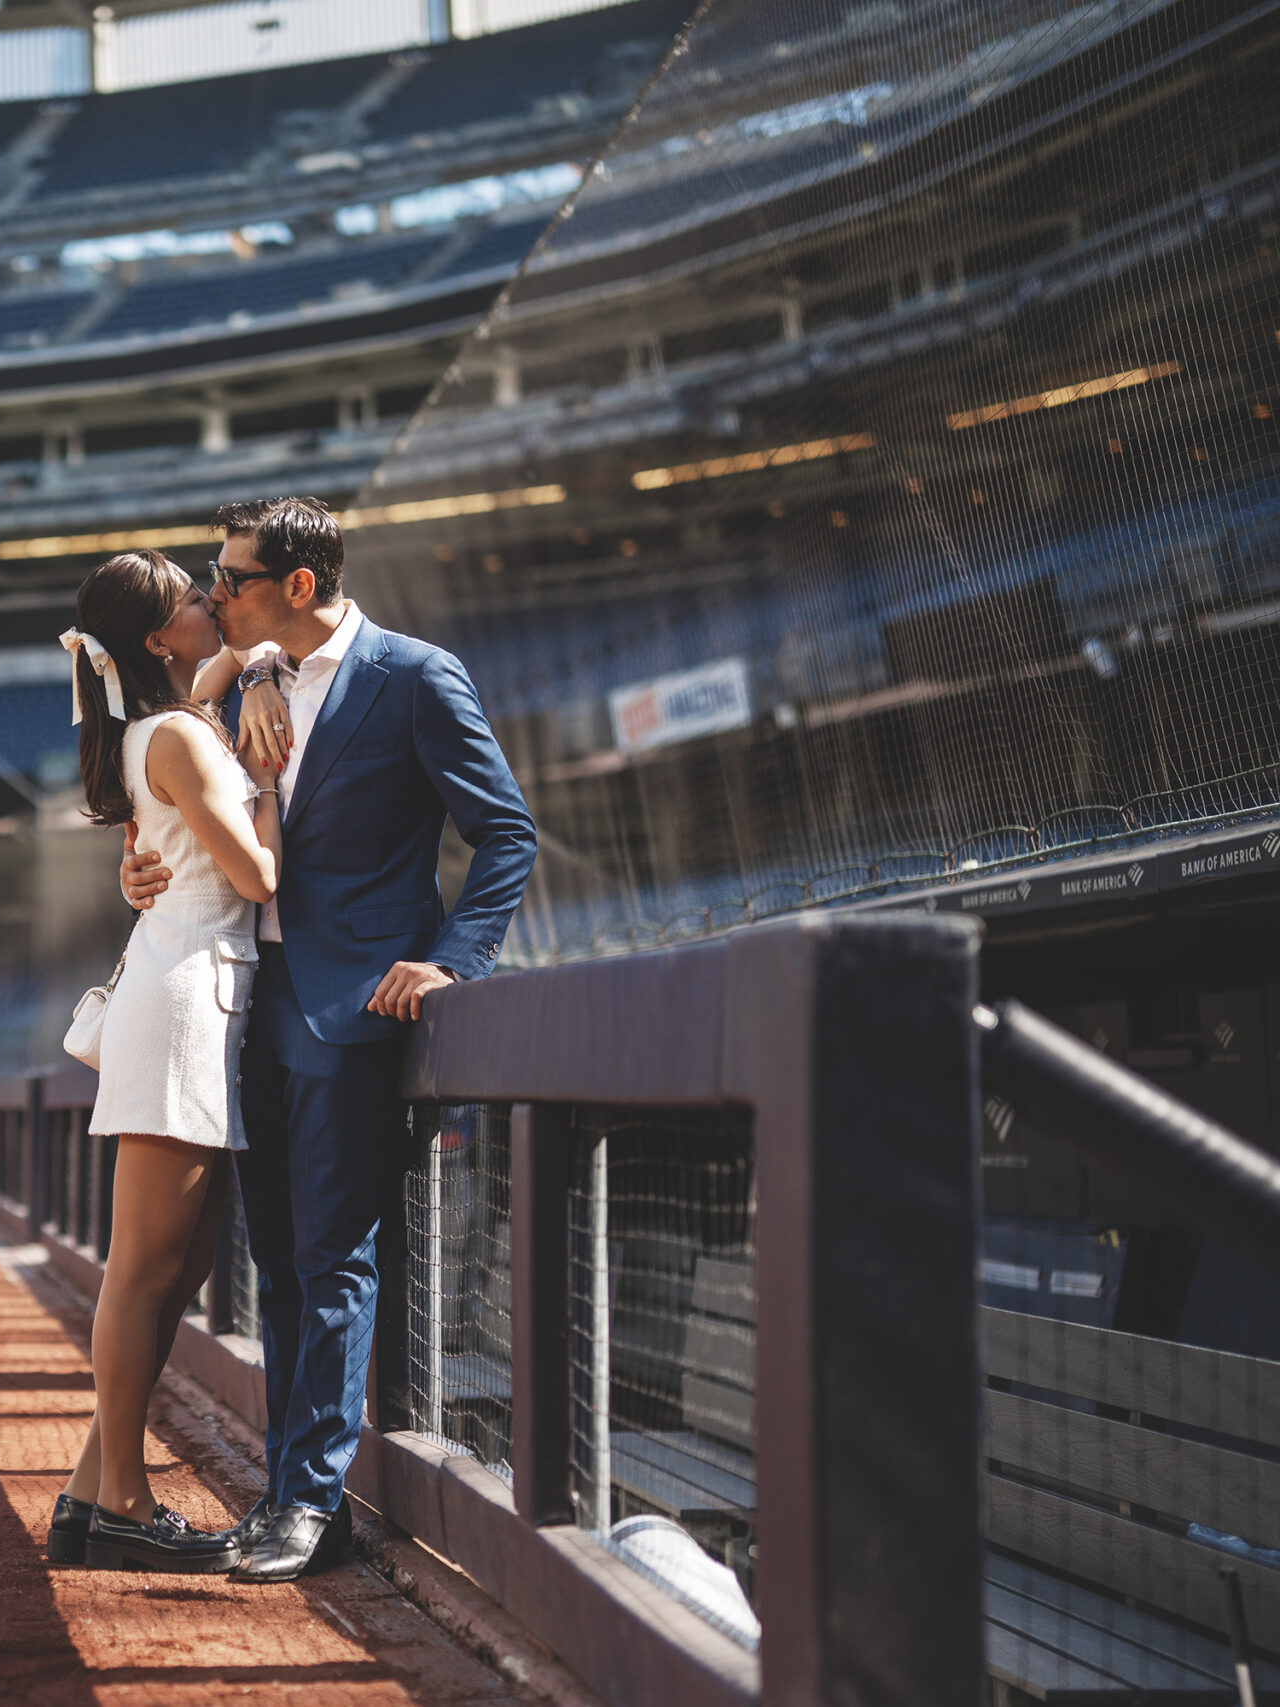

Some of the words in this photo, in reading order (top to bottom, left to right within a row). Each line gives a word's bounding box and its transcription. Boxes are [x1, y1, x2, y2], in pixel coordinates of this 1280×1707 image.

[1181, 858, 1206, 877] BANK
[1207, 855, 1218, 871] OF
[1219, 846, 1261, 868] AMERICA
[988, 888, 1017, 904] AMERICA
[1061, 880, 1081, 896] BANK
[1082, 878, 1091, 893] OF
[1092, 874, 1127, 891] AMERICA
